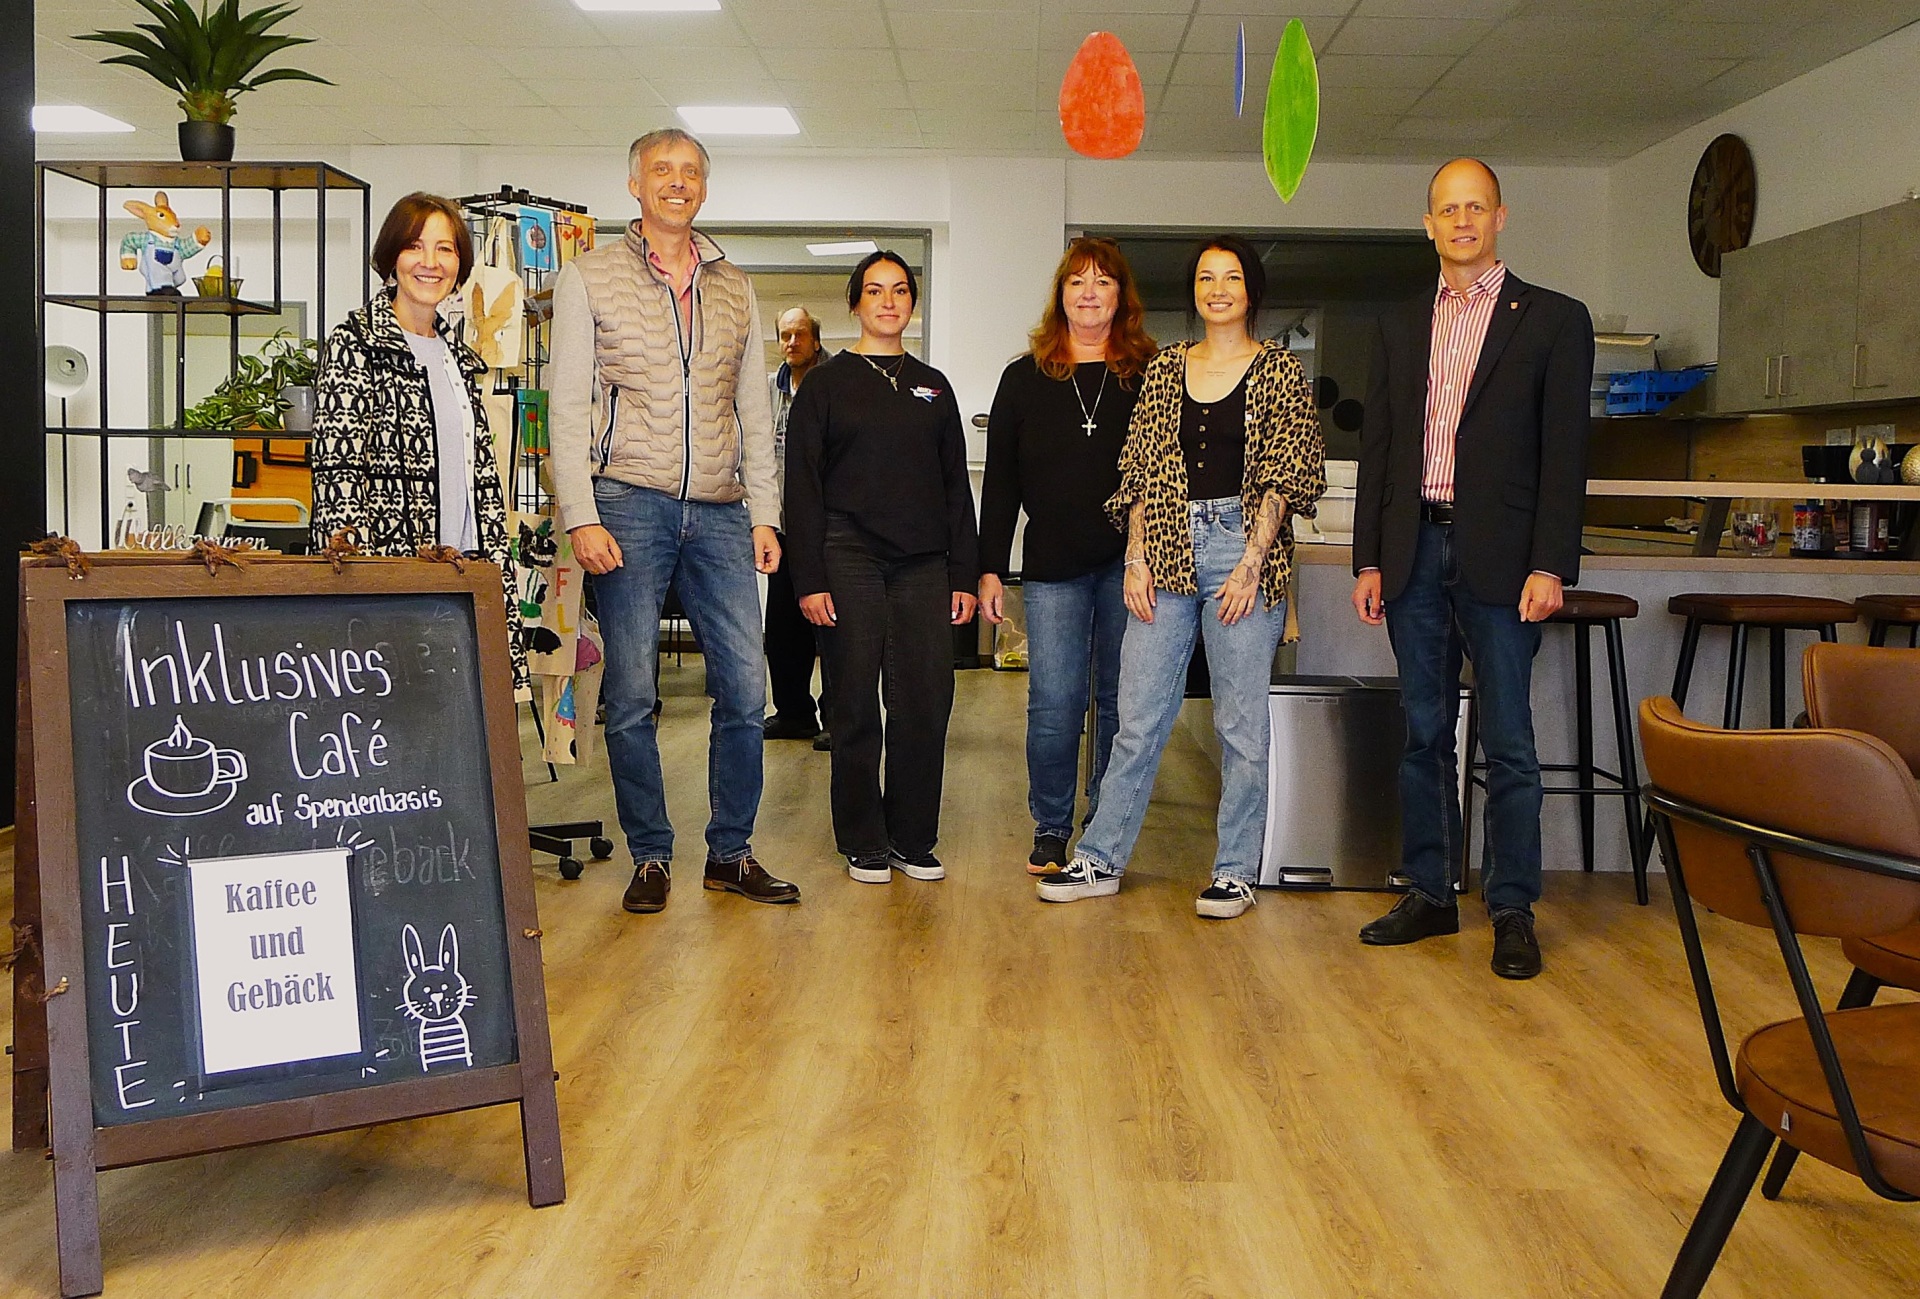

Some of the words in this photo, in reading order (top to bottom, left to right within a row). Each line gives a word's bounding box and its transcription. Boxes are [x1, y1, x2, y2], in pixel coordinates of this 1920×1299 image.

[124, 619, 393, 708] Inklusives
[289, 711, 389, 780] Café
[246, 792, 285, 826] auf
[294, 784, 443, 829] Spendenbasis
[224, 879, 318, 914] Kaffee
[249, 926, 306, 960] und
[100, 855, 156, 1110] HEUTE
[226, 971, 335, 1013] Gebäck
